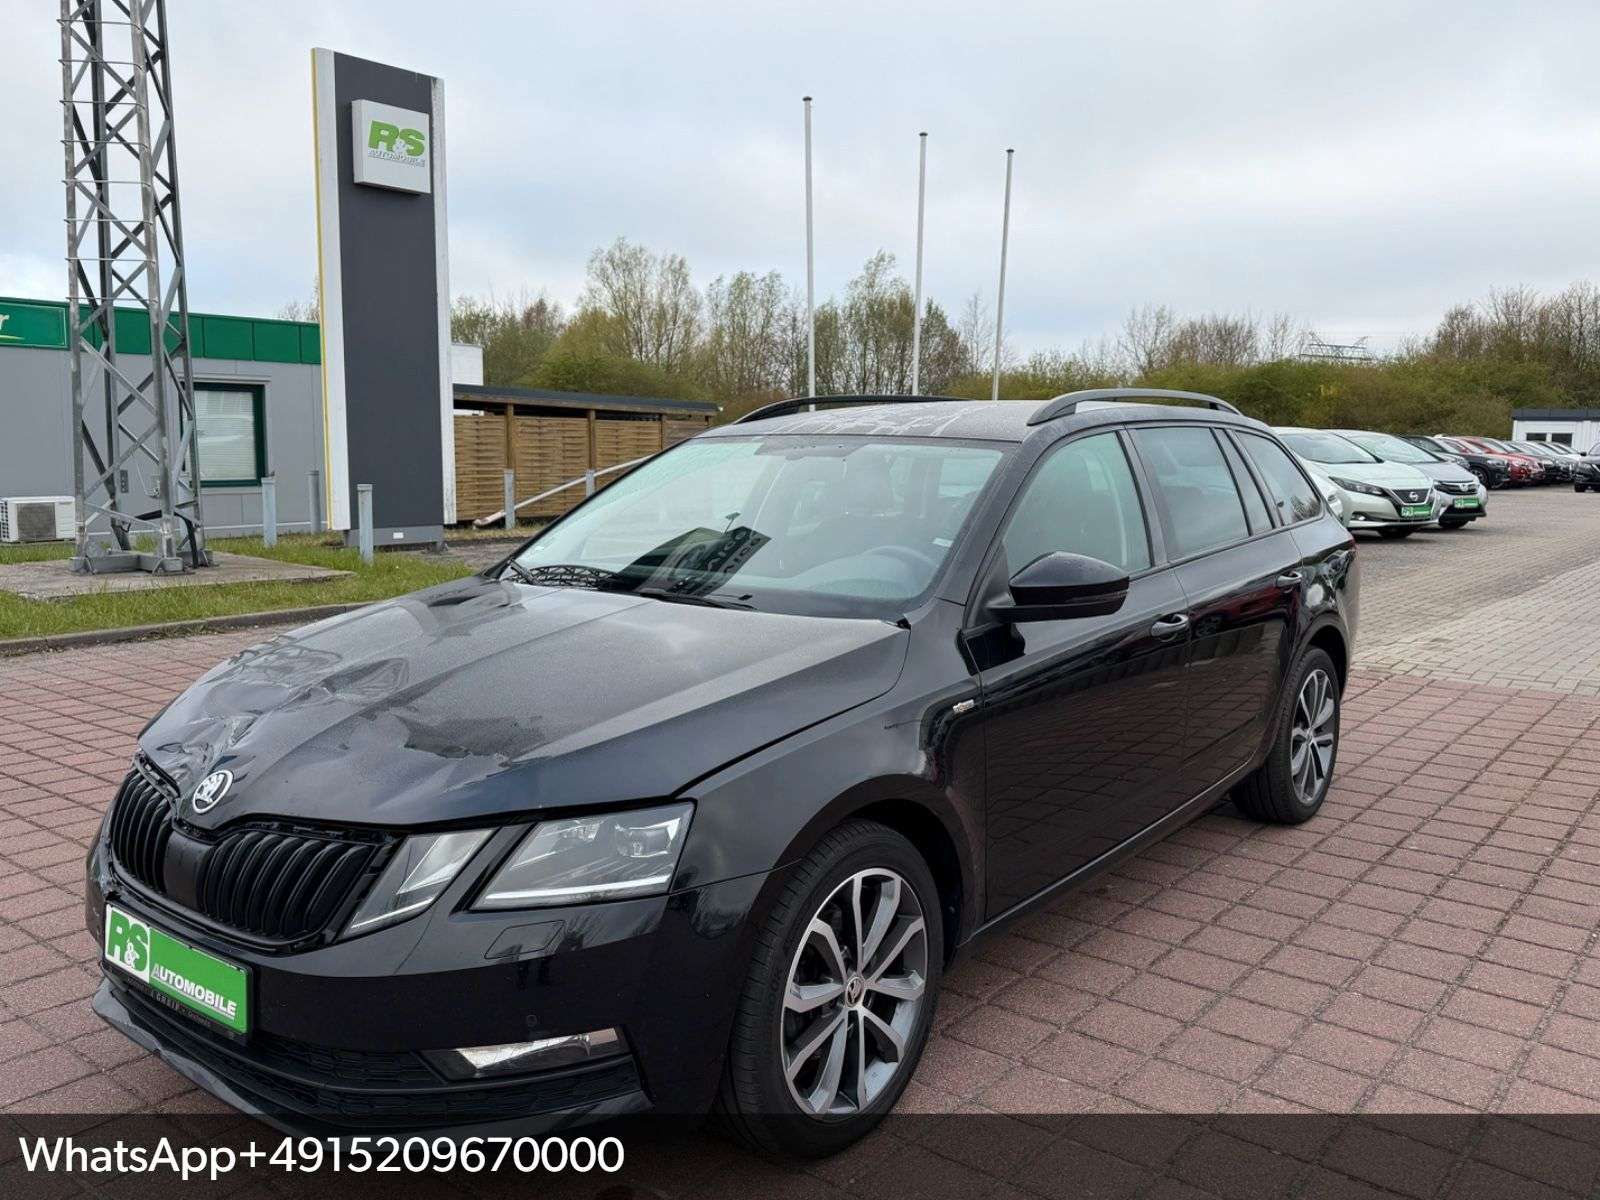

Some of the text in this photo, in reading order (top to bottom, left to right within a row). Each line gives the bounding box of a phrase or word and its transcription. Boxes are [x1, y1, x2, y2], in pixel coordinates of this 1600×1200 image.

[368, 120, 426, 157] R&S
[107, 910, 148, 972] R&S
[151, 963, 237, 1017] AUTOMOBILE
